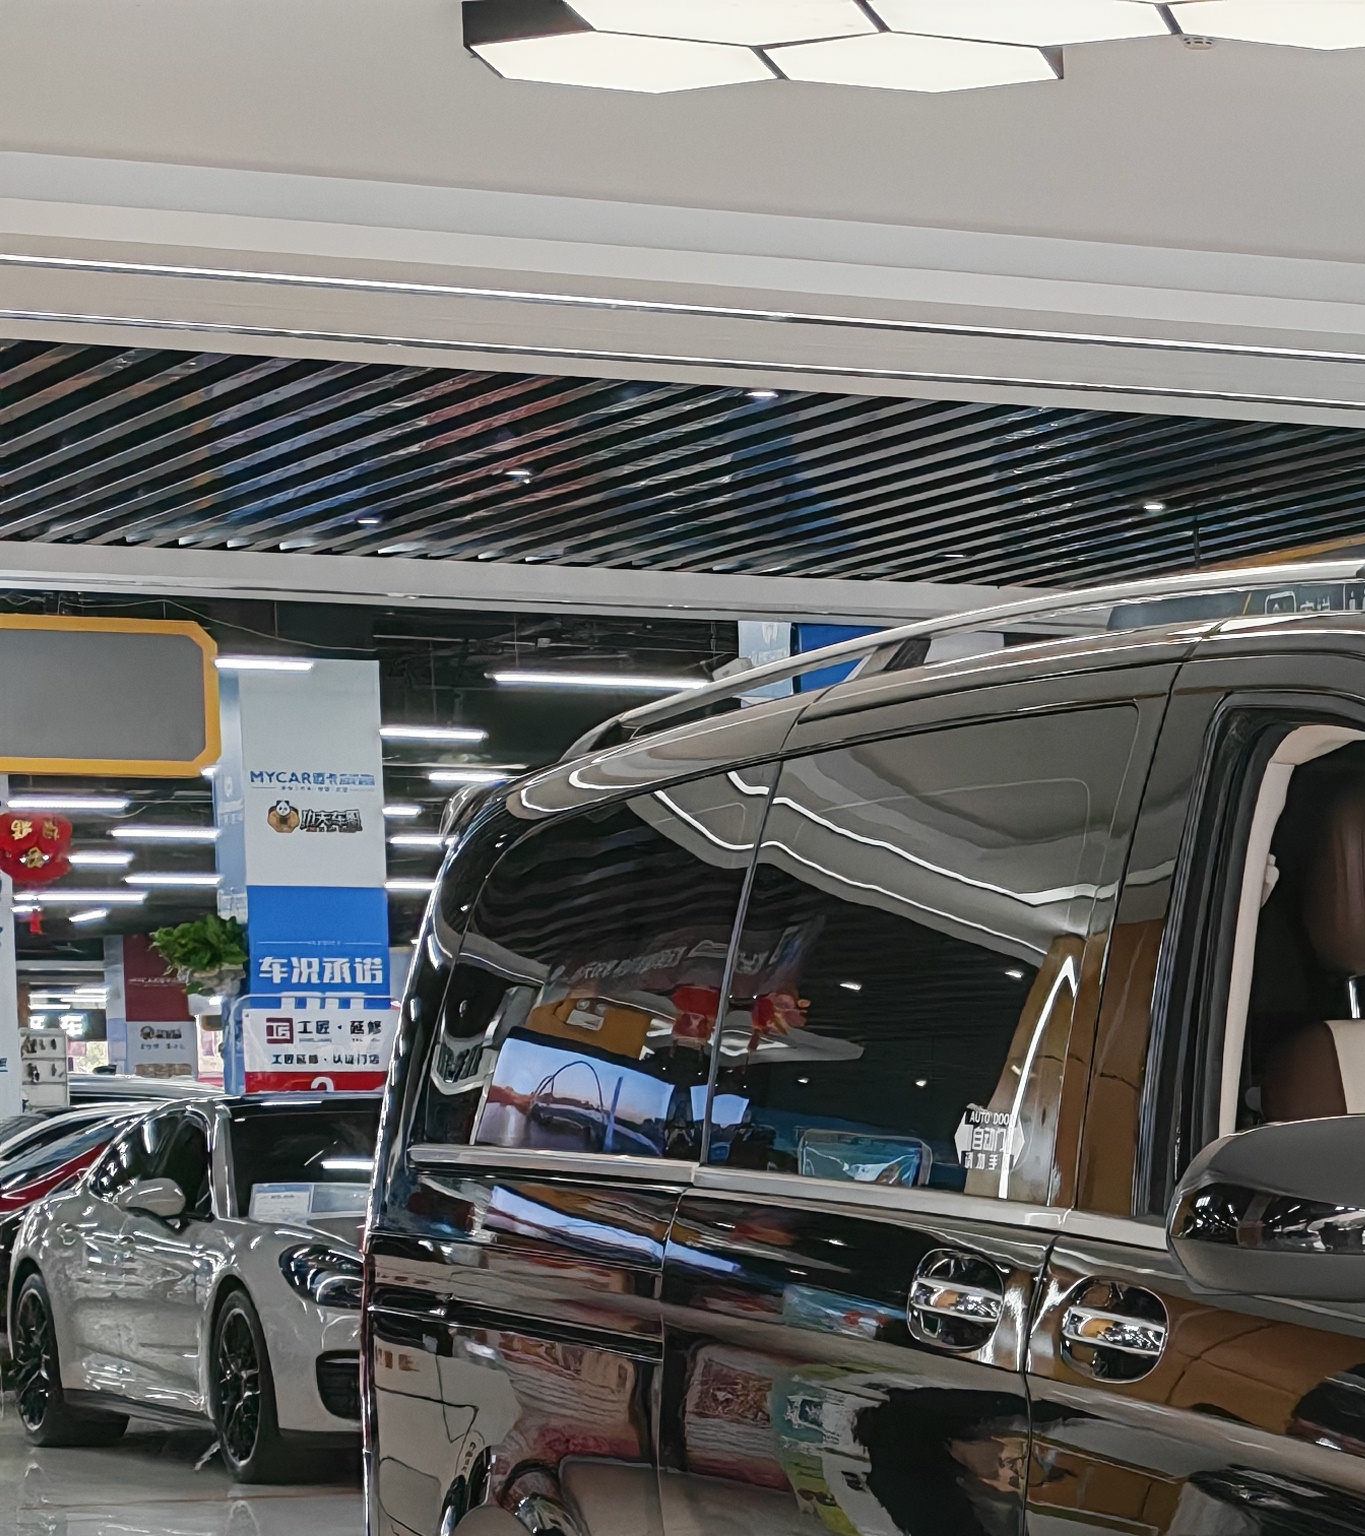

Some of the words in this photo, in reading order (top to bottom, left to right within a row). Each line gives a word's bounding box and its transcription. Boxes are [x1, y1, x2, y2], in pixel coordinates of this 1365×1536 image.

[250, 770, 311, 784] MYCAR
[258, 956, 383, 984] 车况承诺
[970, 1111, 990, 1124] AUTO
